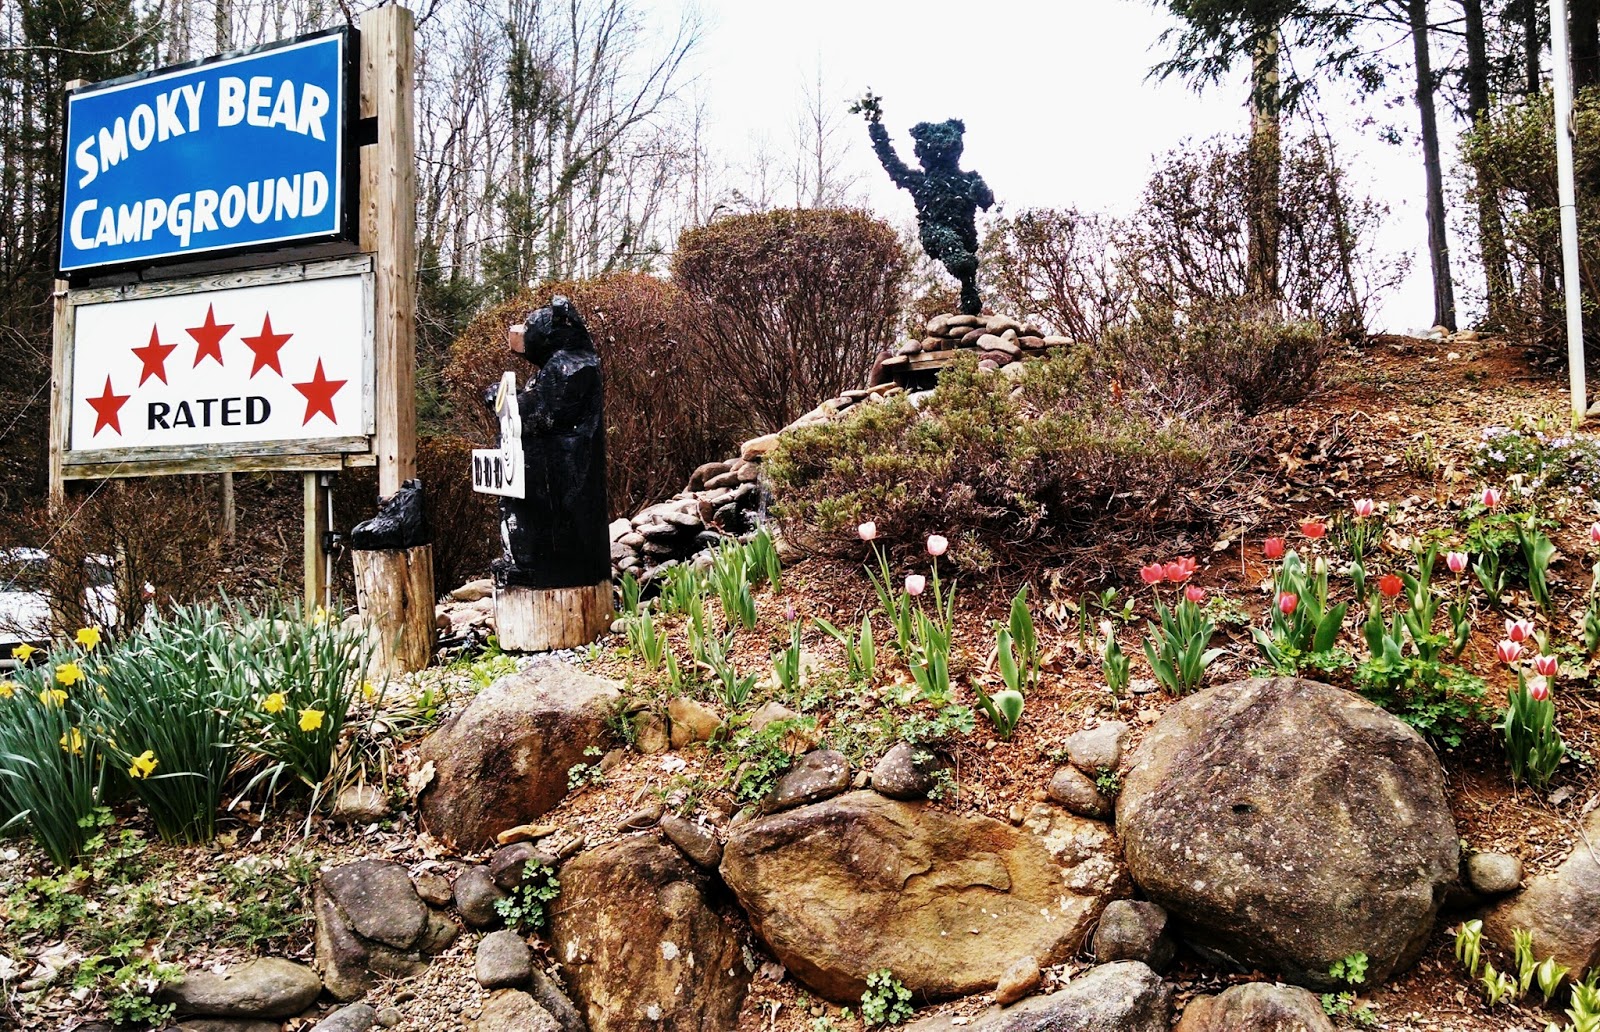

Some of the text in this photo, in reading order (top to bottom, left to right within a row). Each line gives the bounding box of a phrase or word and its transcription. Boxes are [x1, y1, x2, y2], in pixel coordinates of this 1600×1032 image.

[75, 75, 331, 190] SMOKY BEAR
[69, 170, 329, 248] CAMPGROUND
[146, 394, 272, 431] RATED
